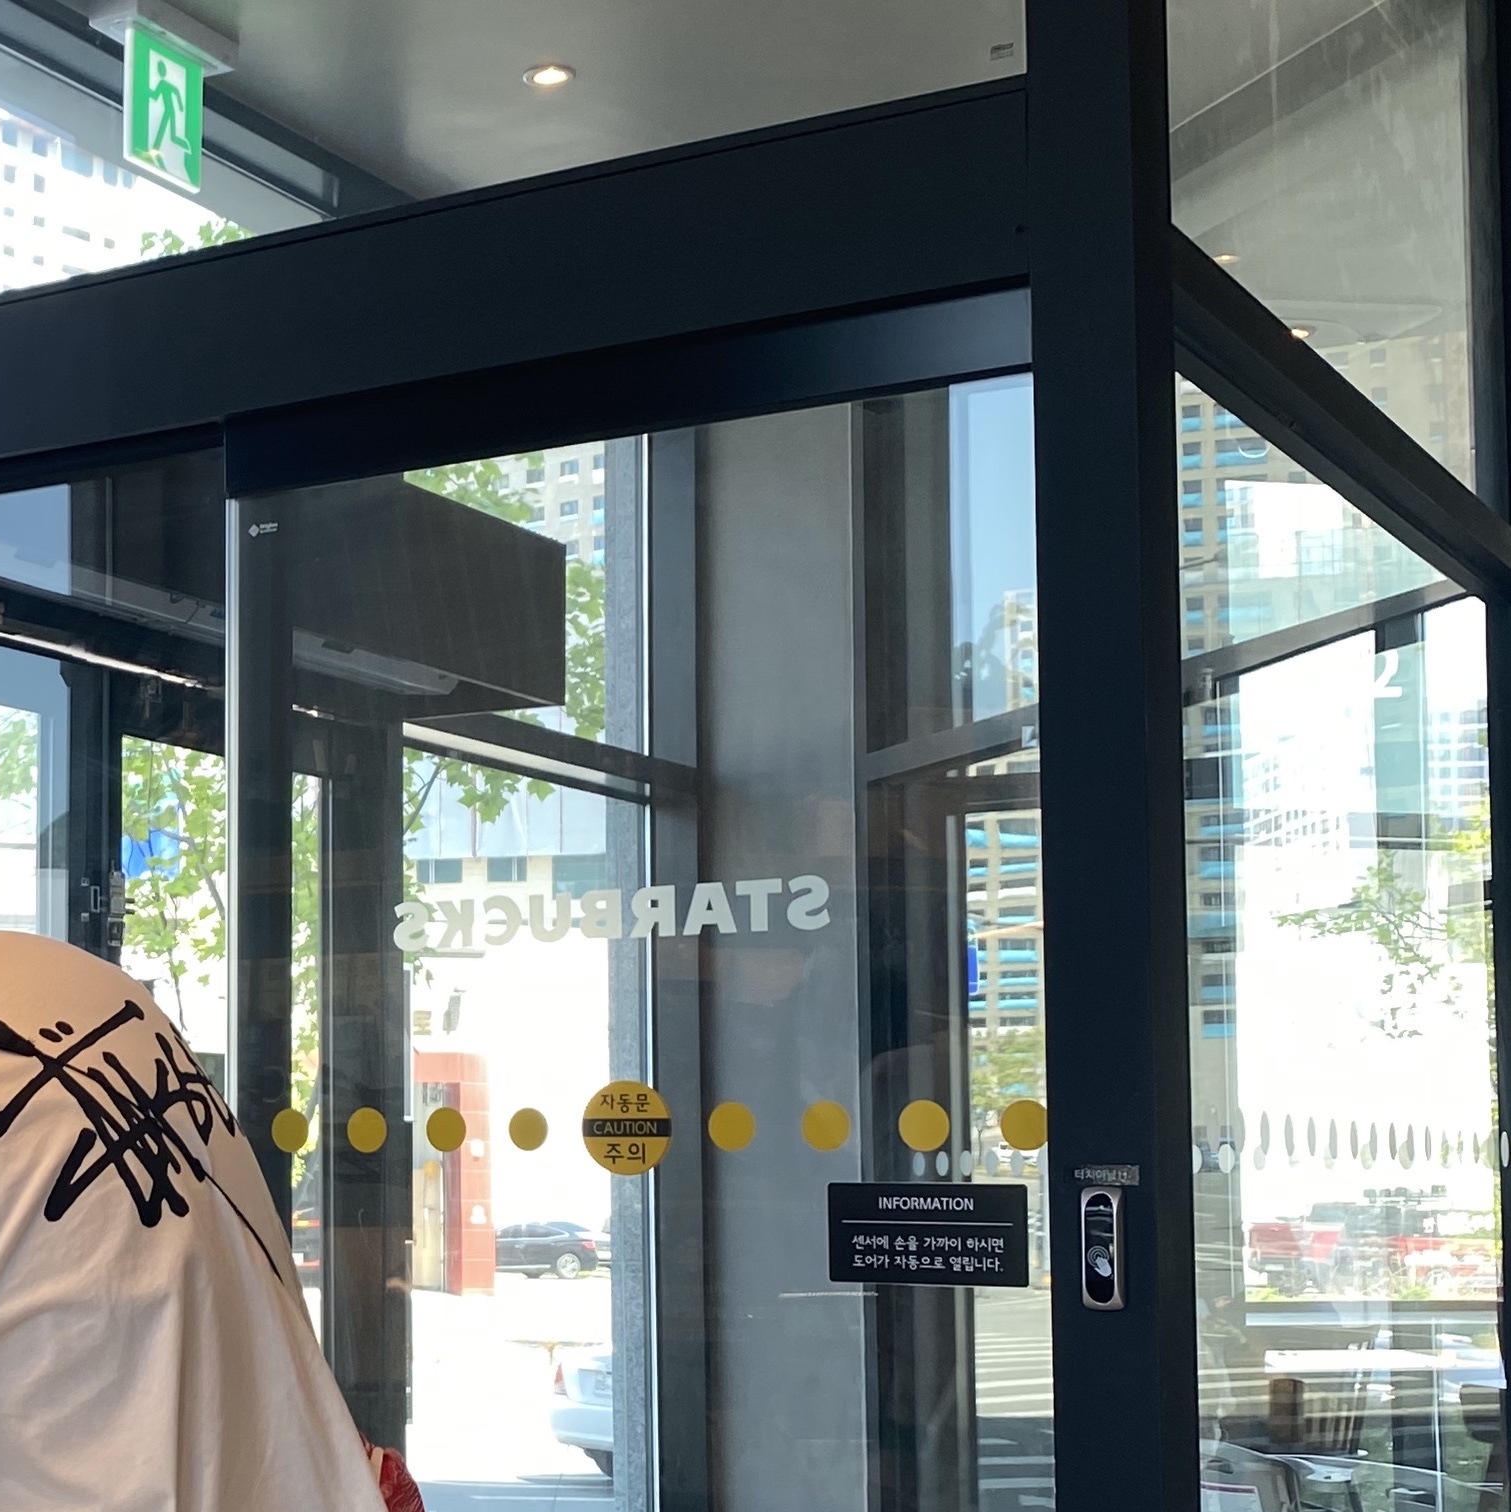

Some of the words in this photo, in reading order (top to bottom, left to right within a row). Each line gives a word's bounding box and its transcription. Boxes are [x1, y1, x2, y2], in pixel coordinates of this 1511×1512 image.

[599, 1093, 651, 1114] 자동문
[592, 1120, 658, 1135] CAUTION
[603, 1142, 646, 1165] 주의
[878, 1196, 975, 1212] INFORMATION
[851, 1234, 889, 1250] 센서에
[893, 1235, 920, 1252] 손을
[922, 1236, 962, 1252] 가까이
[965, 1237, 1005, 1254] 하시면
[852, 1253, 890, 1269] 도어가
[893, 1255, 946, 1271] 자동으로
[949, 1256, 1005, 1273] 열립니다.
